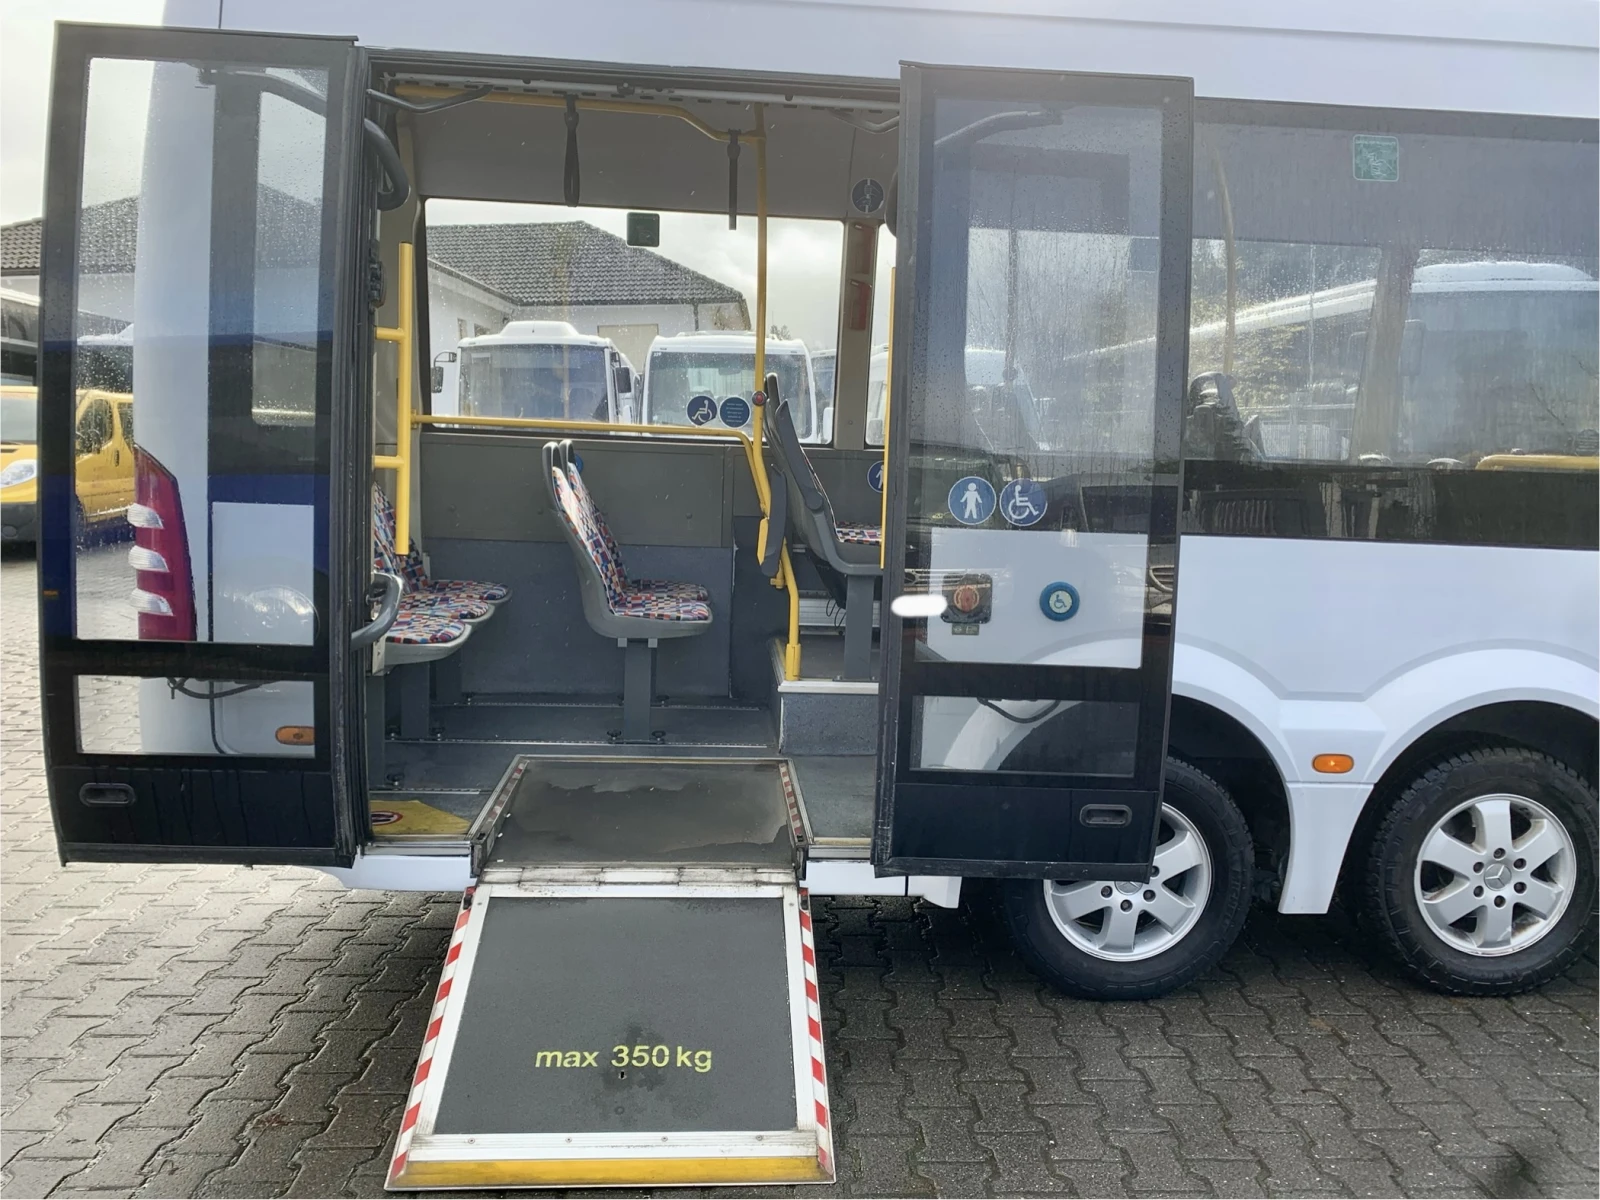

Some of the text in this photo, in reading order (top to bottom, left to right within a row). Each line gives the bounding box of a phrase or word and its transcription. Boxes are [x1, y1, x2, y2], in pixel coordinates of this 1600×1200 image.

[535, 1045, 712, 1073] max 350 kg
